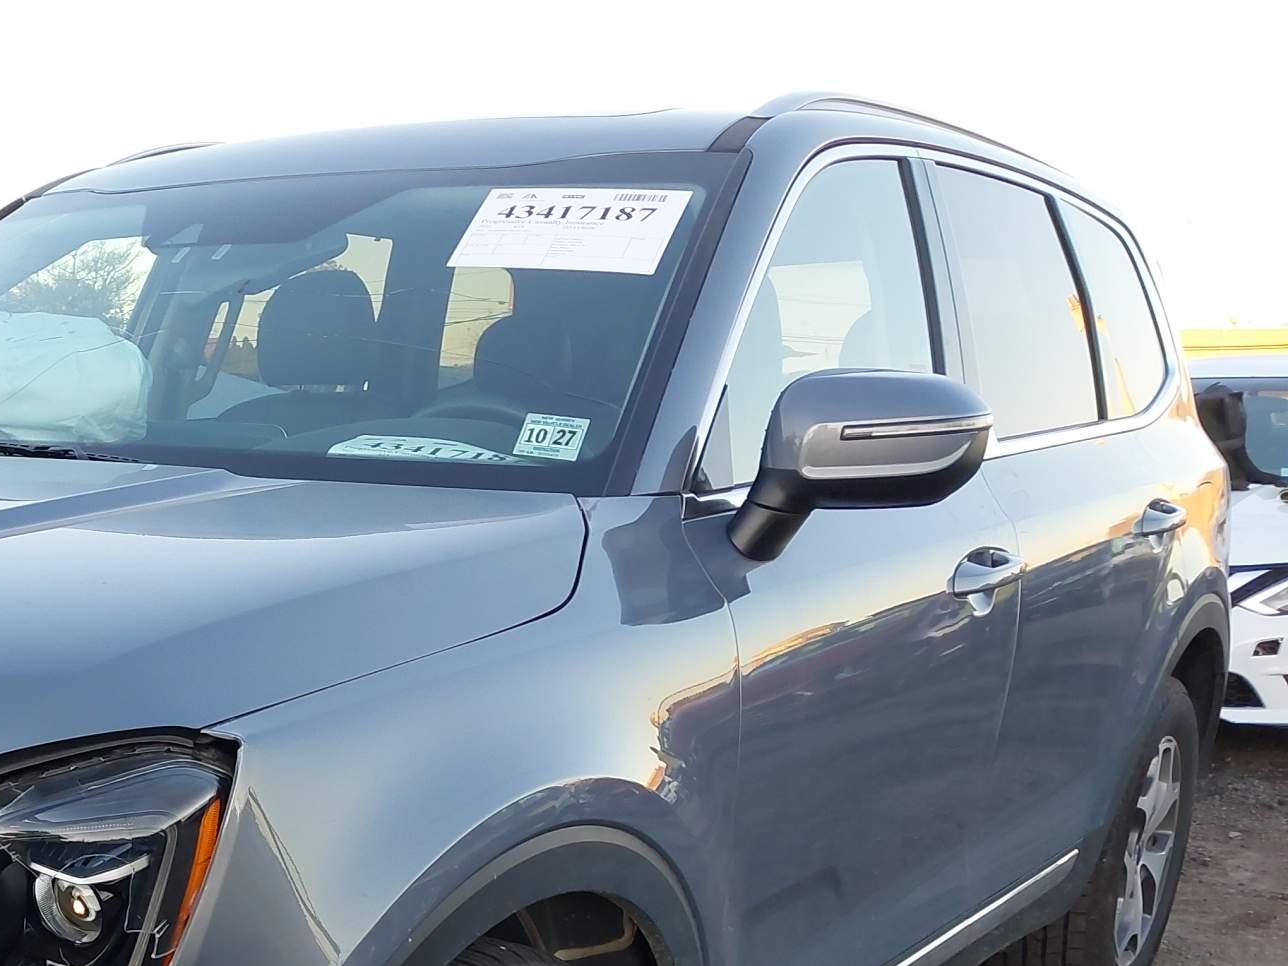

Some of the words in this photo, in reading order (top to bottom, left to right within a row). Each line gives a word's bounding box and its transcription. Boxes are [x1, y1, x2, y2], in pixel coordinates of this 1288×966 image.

[496, 204, 658, 222] 43417187
[523, 428, 548, 444] 10
[552, 429, 579, 446] 27
